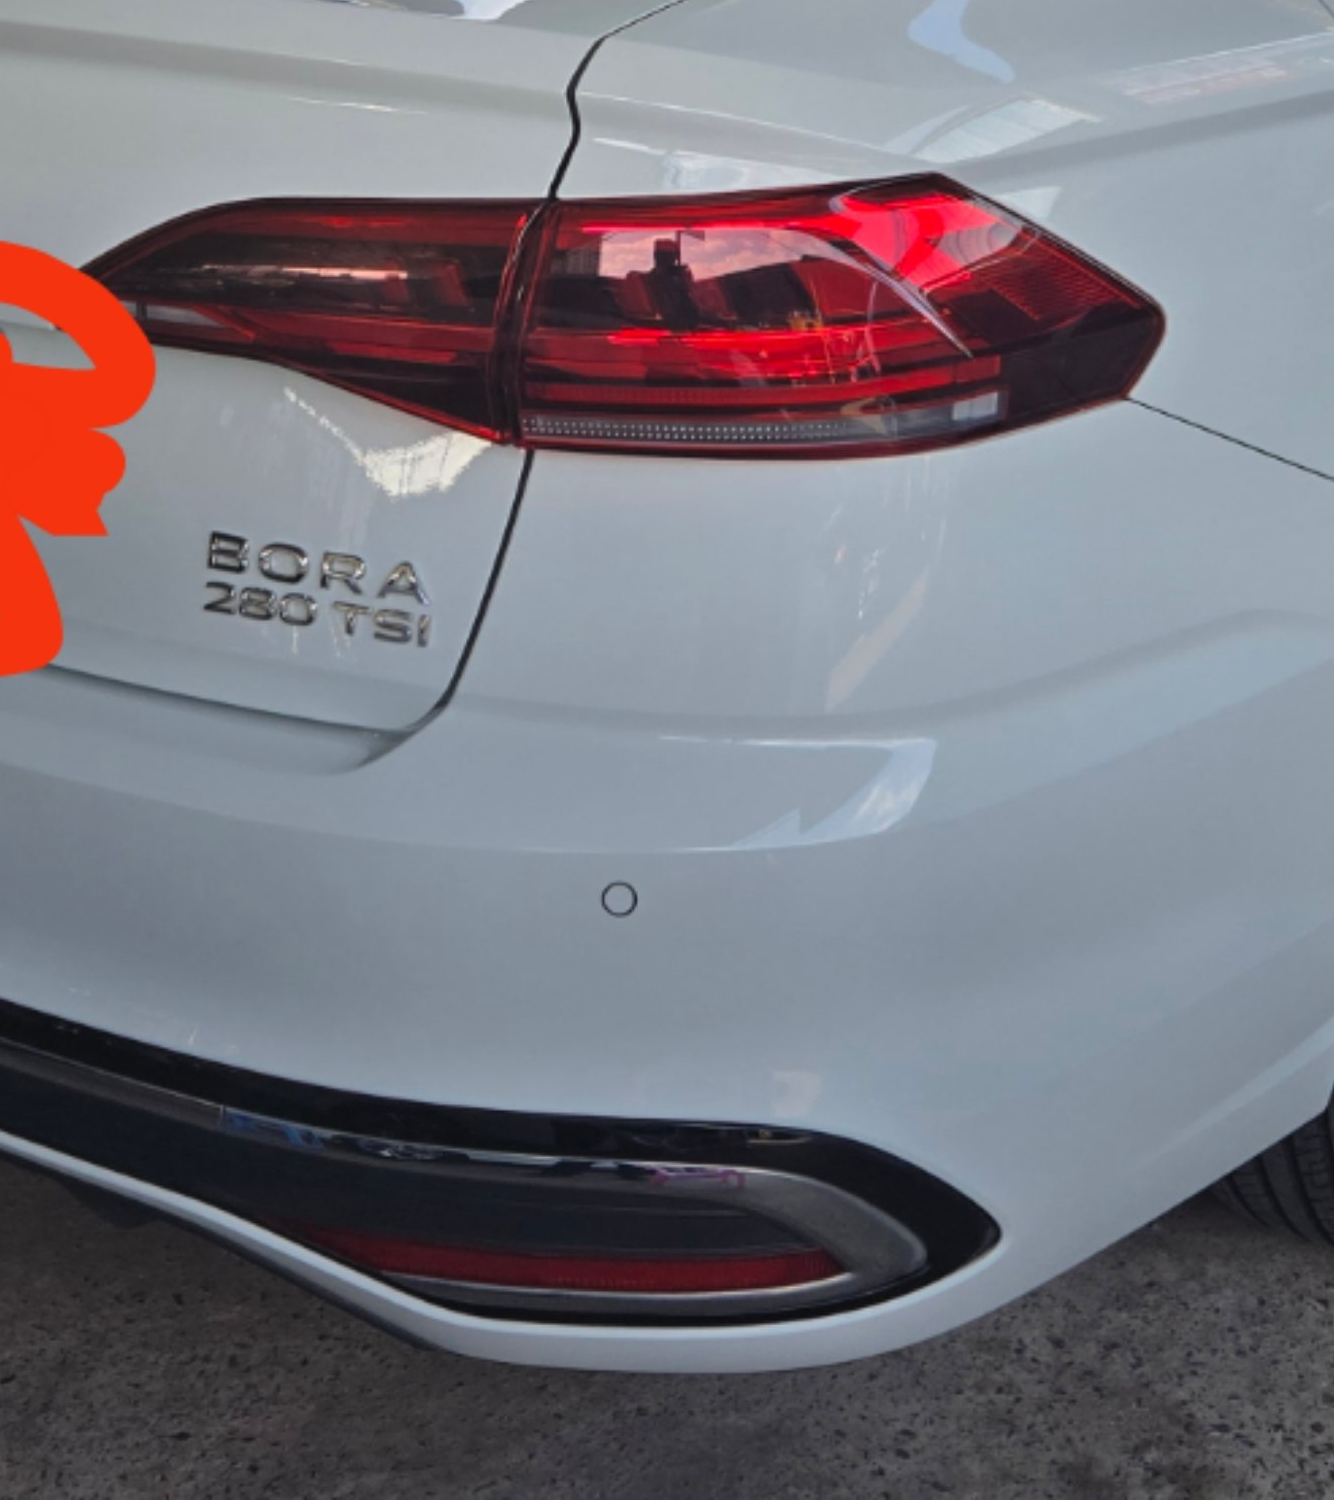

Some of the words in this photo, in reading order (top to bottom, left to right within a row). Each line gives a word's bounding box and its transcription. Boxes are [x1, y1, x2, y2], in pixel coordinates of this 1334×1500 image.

[207, 530, 431, 606] BORA
[203, 581, 317, 627] 280
[333, 600, 431, 648] TSI
